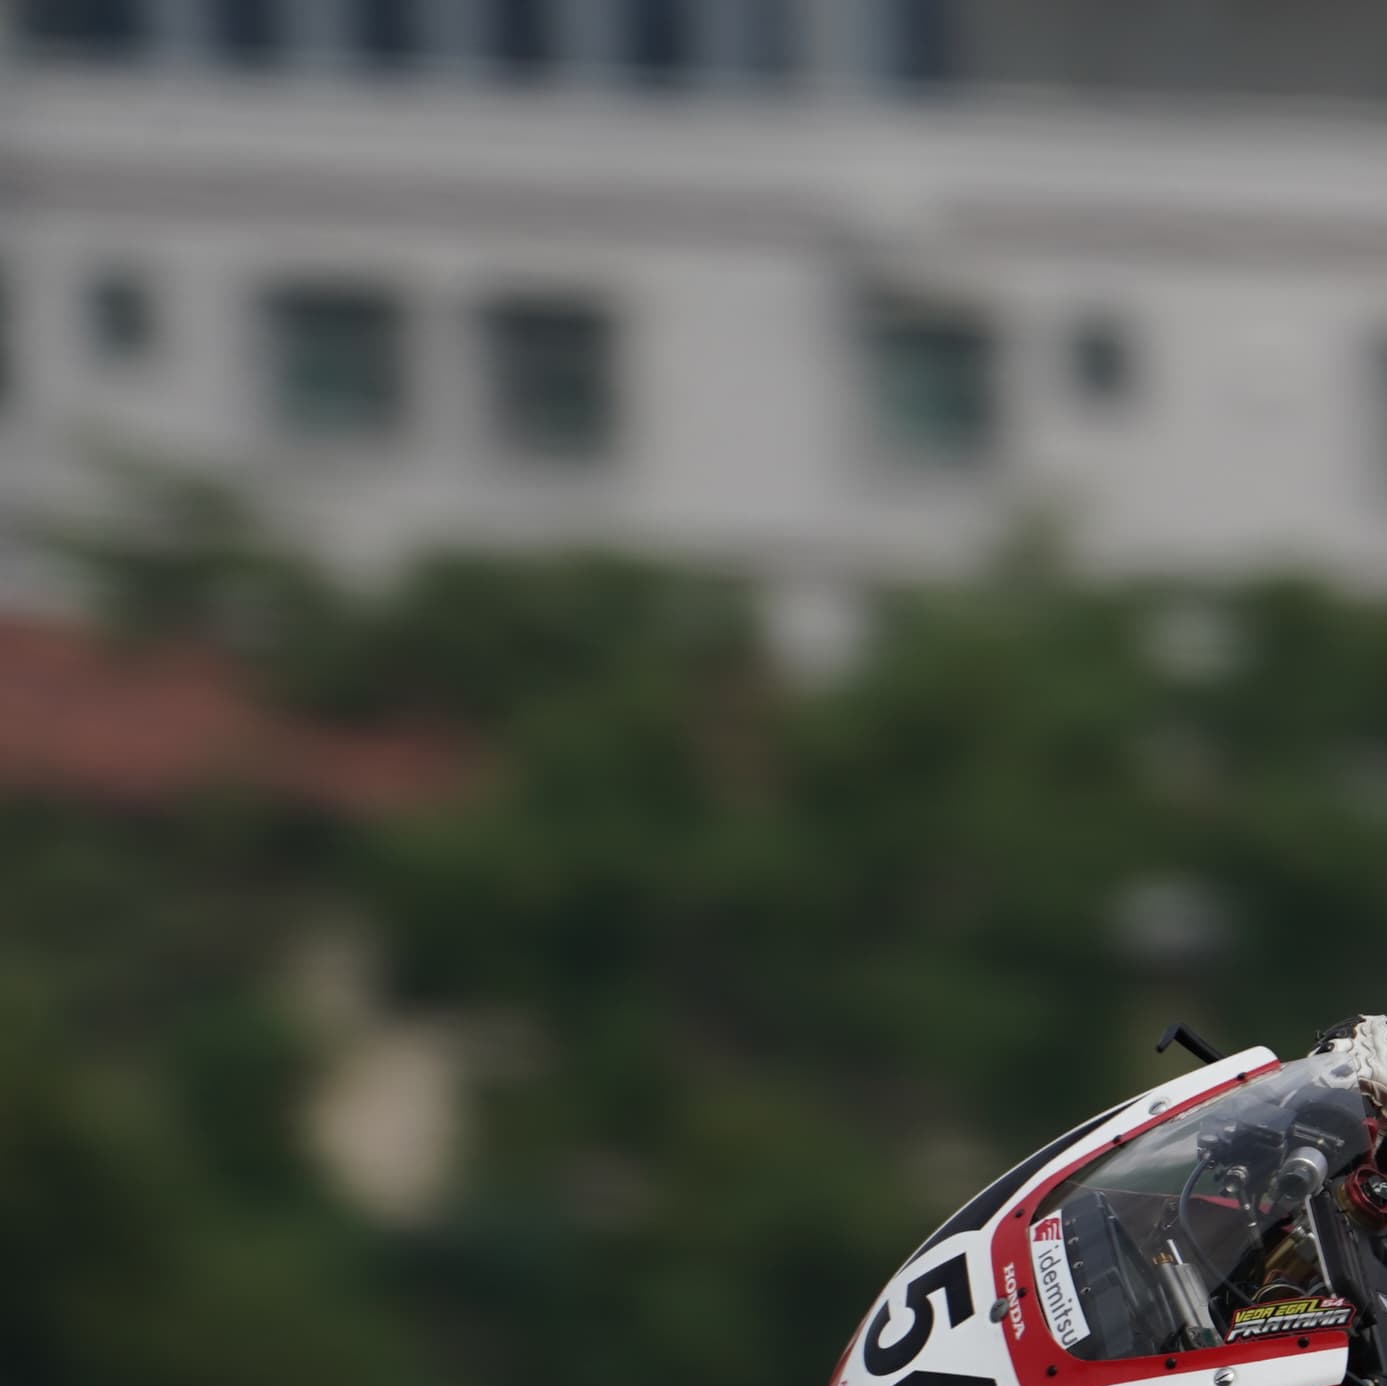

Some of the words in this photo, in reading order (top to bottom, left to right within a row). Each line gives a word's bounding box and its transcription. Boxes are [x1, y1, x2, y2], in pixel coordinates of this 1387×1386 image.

[1003, 1261, 1026, 1340] HONDA
[1038, 1245, 1079, 1346] idemitsu
[1235, 1307, 1275, 1323] VEDA
[1226, 1309, 1351, 1342] PRATAMA
